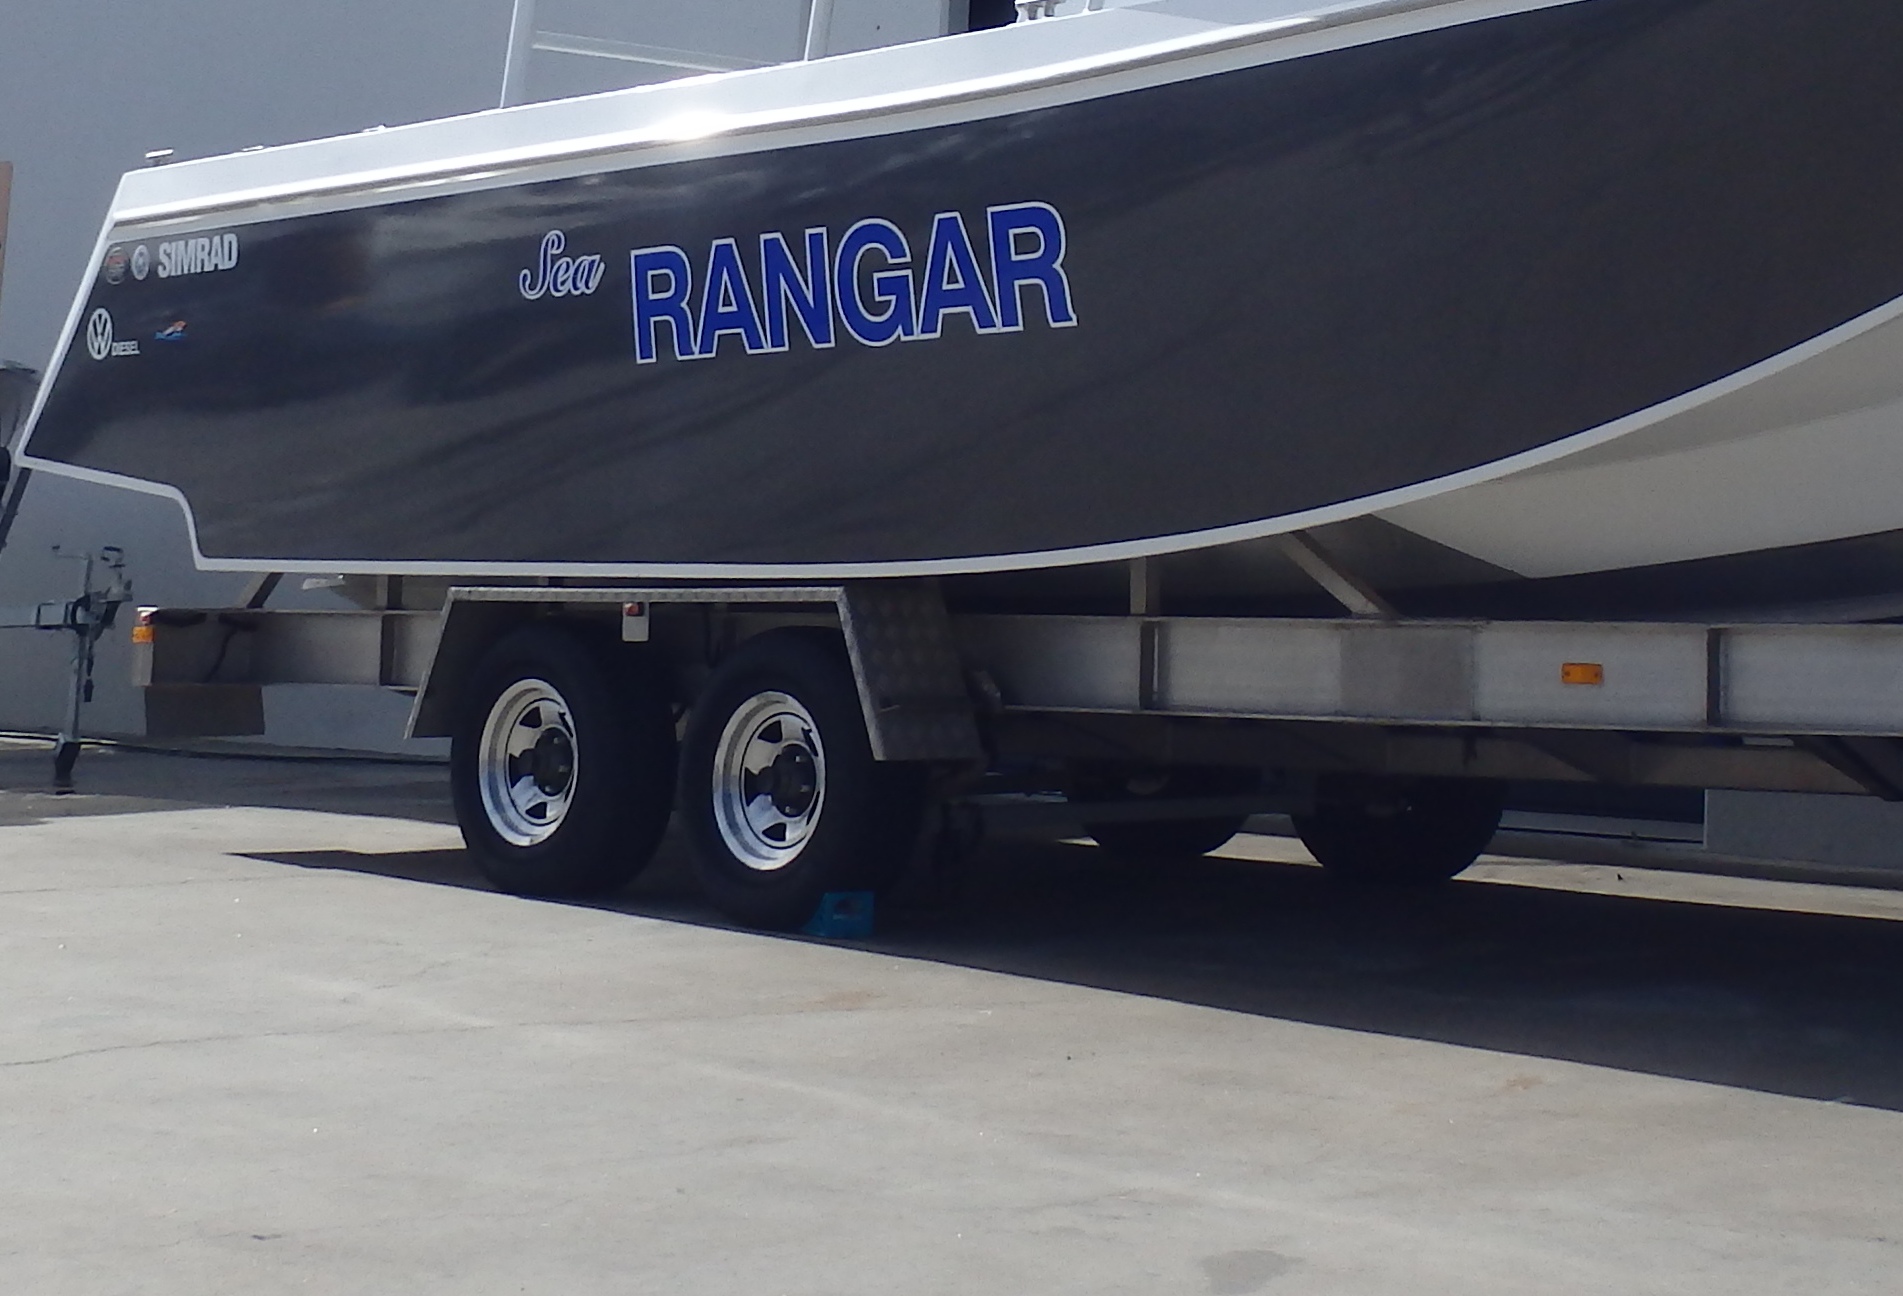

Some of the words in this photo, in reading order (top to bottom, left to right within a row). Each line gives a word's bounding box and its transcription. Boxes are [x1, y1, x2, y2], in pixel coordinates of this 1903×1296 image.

[157, 233, 239, 279] SIMRAD
[519, 229, 605, 300] Sea
[629, 201, 1078, 364] RANGAR
